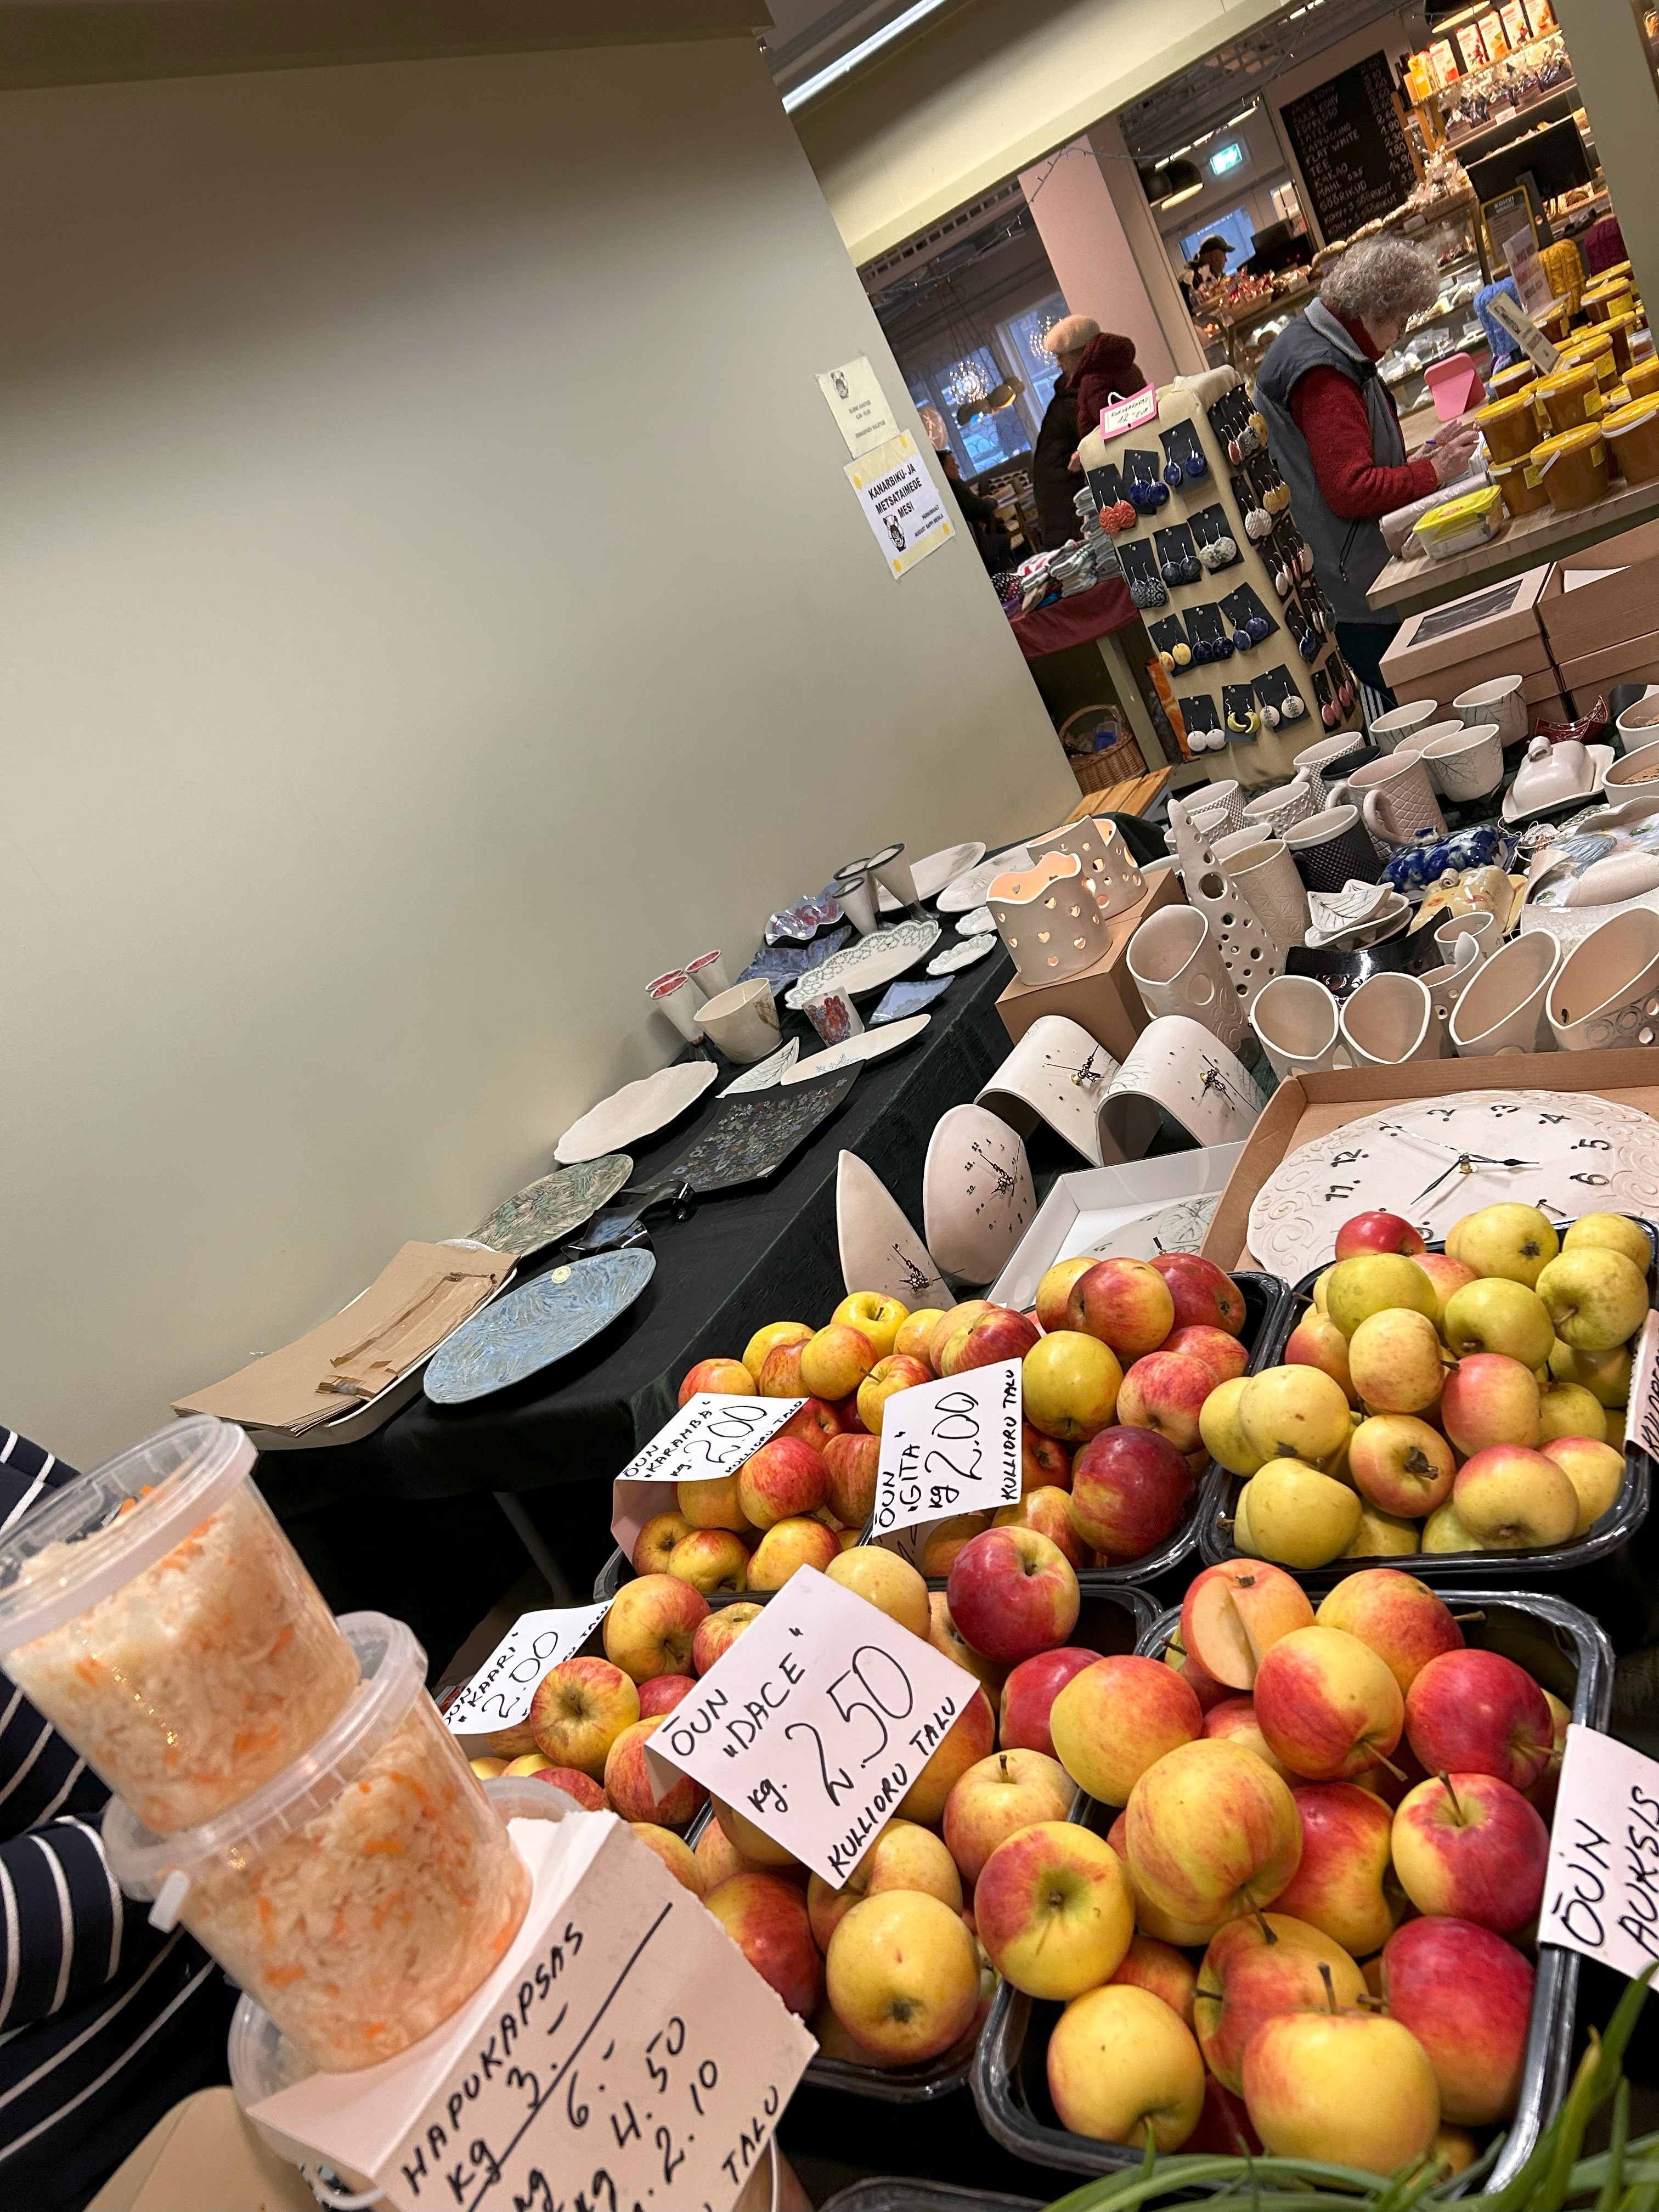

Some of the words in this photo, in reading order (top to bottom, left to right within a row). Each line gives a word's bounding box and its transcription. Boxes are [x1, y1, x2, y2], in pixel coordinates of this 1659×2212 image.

[1331, 128, 1360, 153] WHITE
[1309, 159, 1331, 177] TEE
[1314, 162, 1348, 189] KAKAO
[1316, 179, 1342, 198] MAHL
[1494, 195, 1514, 210] KOHVI
[868, 469, 907, 500] KANARBIKU-
[907, 463, 916, 475] JA
[875, 477, 922, 515] METSATAIMEDE
[898, 501, 915, 519] MESI
[1426, 1109, 1457, 1117] 2
[1491, 1105, 1521, 1114] 3
[1540, 1113, 1571, 1125] 4
[1578, 1138, 1613, 1151] 5
[1331, 1149, 1362, 1168] 12
[1325, 1184, 1355, 1201] 11
[1575, 1173, 1610, 1186] 6
[1002, 1369, 1018, 1409] TALU
[772, 1400, 803, 1425] TALU
[684, 1406, 768, 1463] 2.00
[924, 1391, 983, 1480] 2.00
[1001, 1416, 1018, 1500] KULLIORU
[481, 1631, 559, 1719] 2.00
[785, 1645, 914, 1807] 2.50
[826, 1763, 909, 1878] KULLIORU
[909, 1696, 957, 1756] TALU
[401, 1922, 584, 2196] HAPUKAPSAS
[610, 2016, 686, 2149] 4.50
[656, 2059, 718, 2185] 2.10
[720, 2085, 779, 2186] TALU
